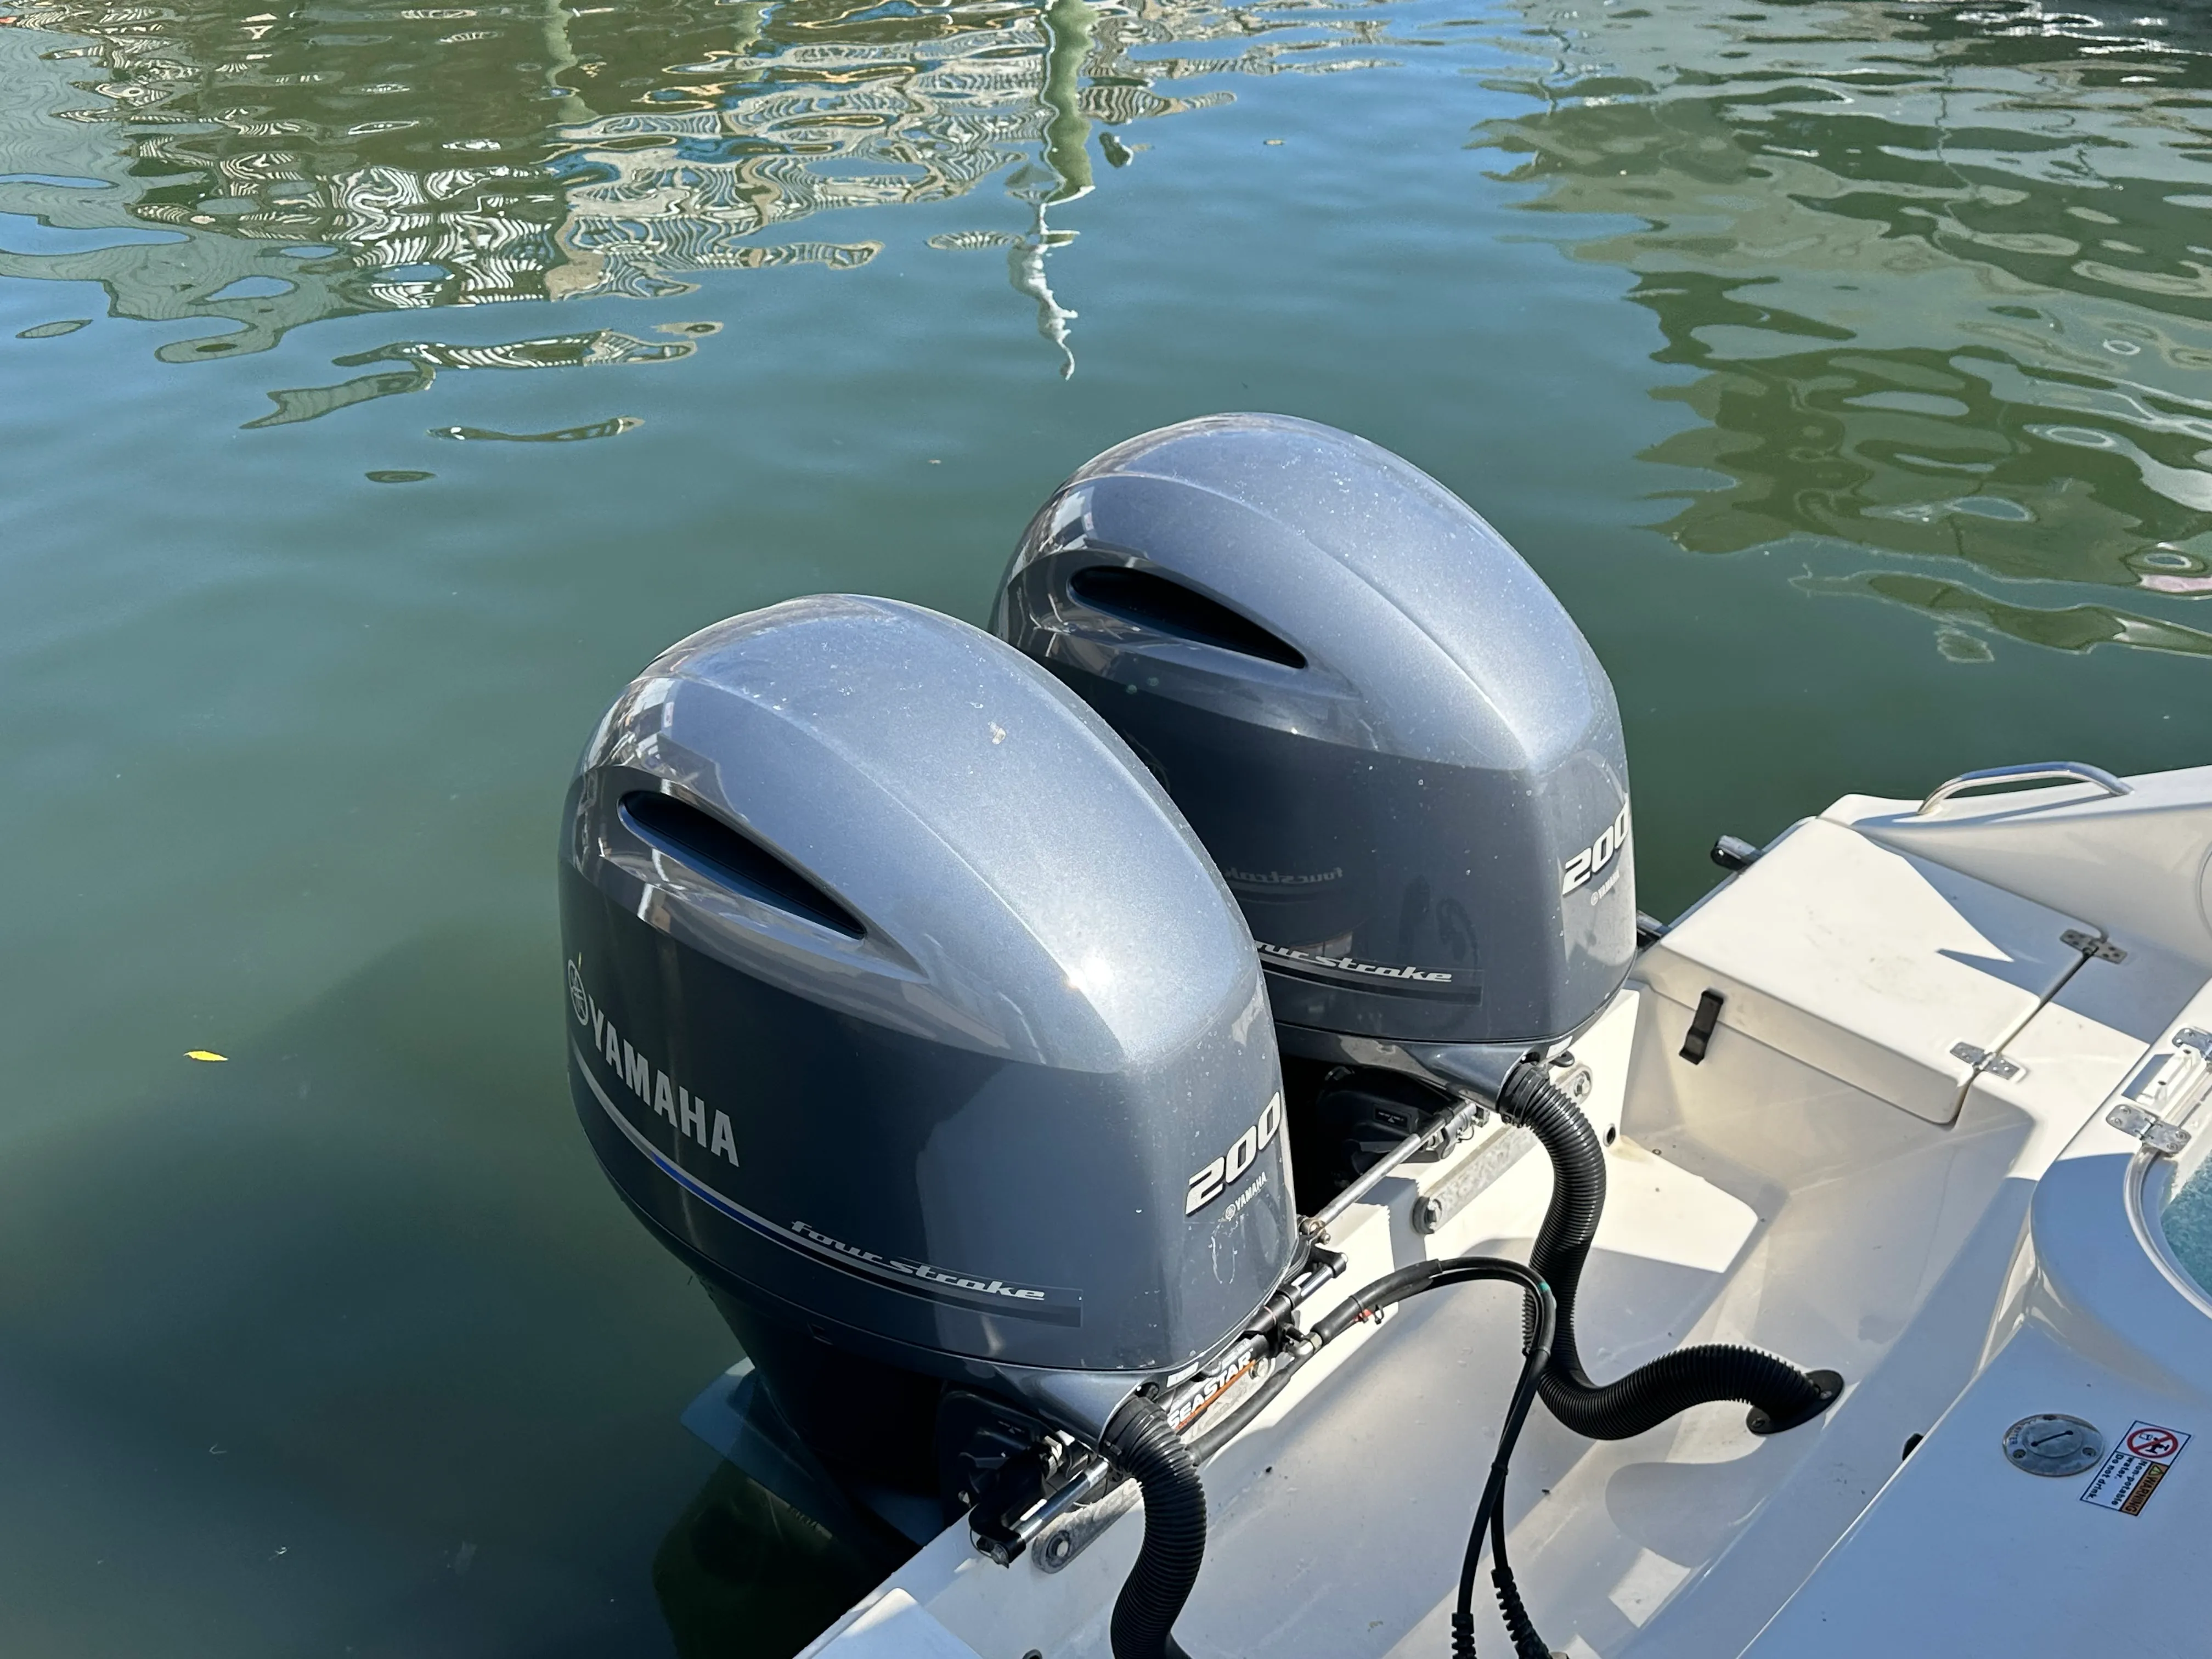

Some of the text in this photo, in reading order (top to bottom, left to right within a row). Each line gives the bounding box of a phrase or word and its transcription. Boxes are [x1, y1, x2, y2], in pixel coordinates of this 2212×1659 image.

[1562, 801, 1629, 895] 200
[1315, 955, 1452, 983] stroke
[588, 996, 740, 1167] YAMAHA
[1185, 1091, 1281, 1216] 200
[1234, 1171, 1267, 1211] YAMAHA
[791, 1220, 1045, 1301] four stroke
[2086, 1454, 2124, 1500] Do not drink.
[2111, 1459, 2147, 1505] Non-potable
[2114, 1457, 2134, 1480] water.
[2125, 1476, 2157, 1513] WARNING
